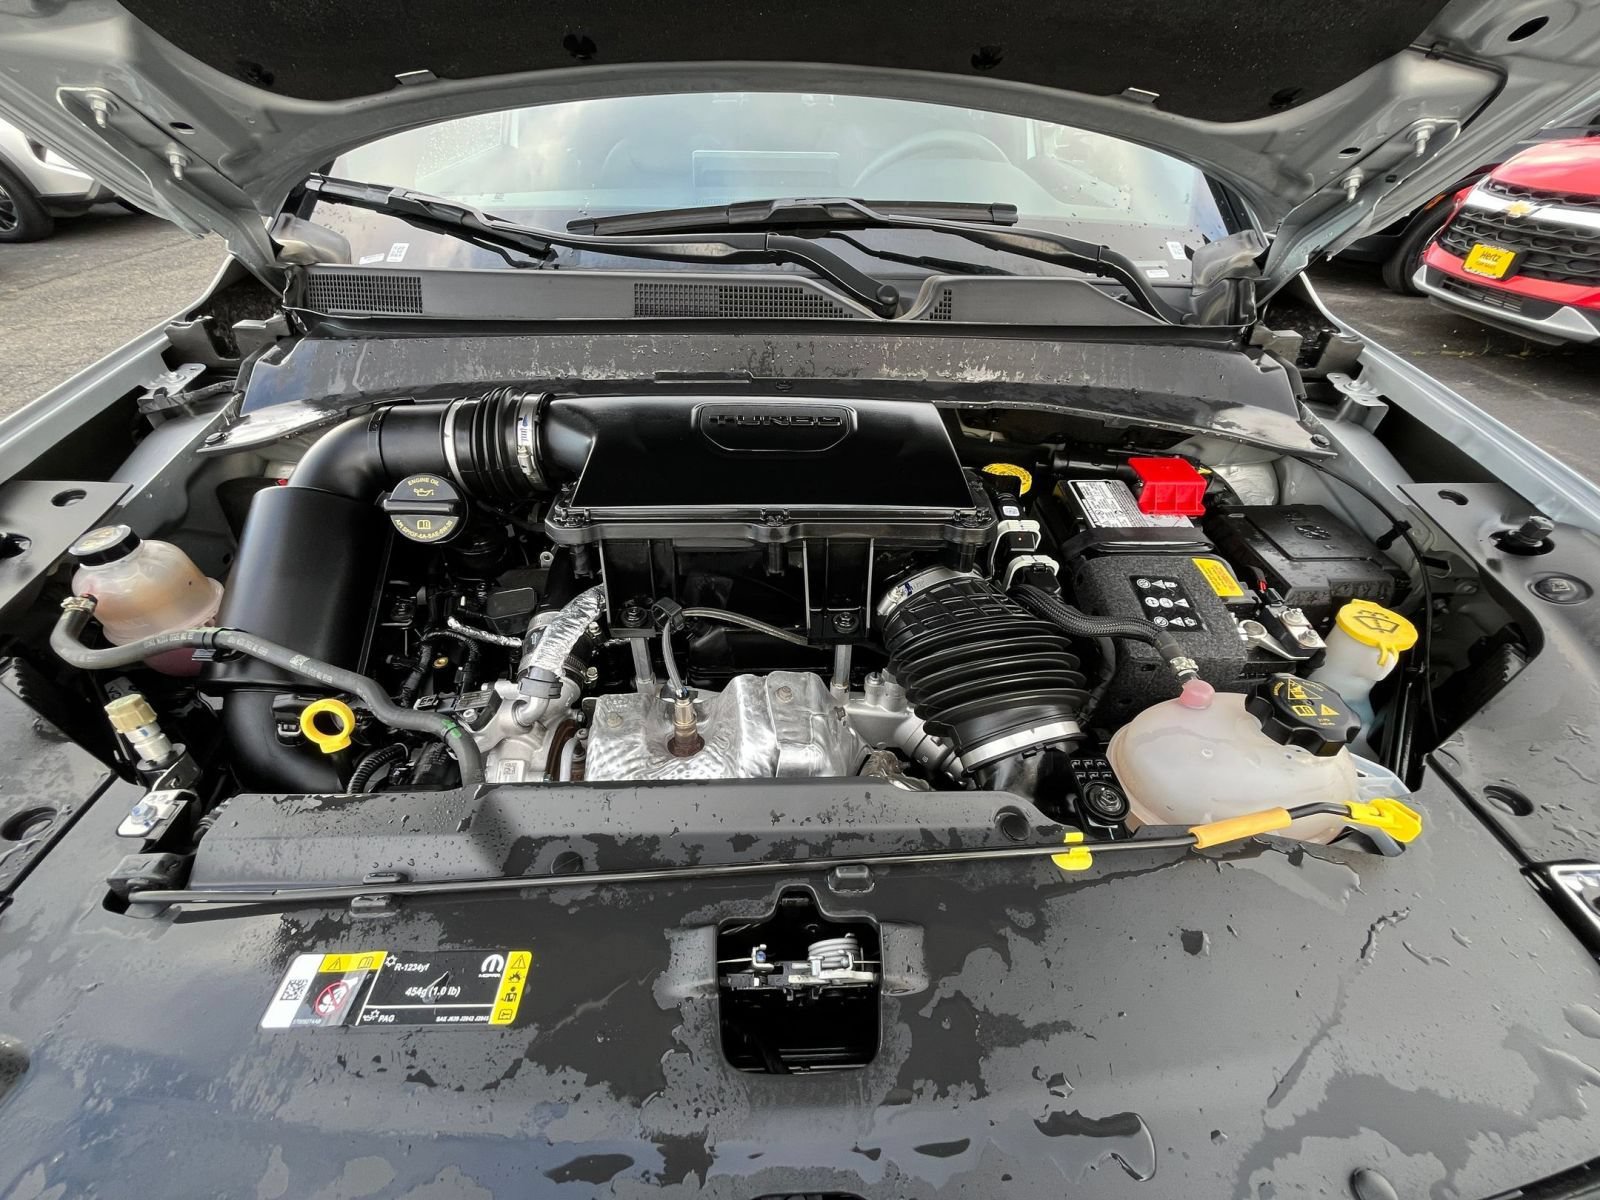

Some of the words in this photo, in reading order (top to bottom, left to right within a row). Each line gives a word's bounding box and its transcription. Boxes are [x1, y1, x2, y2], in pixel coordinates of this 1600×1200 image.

[407, 477, 430, 486] ENGINE
[430, 478, 440, 487] OIL
[394, 962, 430, 973] R-1234yf
[405, 986, 427, 998] 454g
[428, 986, 446, 998] (1.0
[447, 986, 461, 998] lb)
[378, 1014, 395, 1023] PAG
